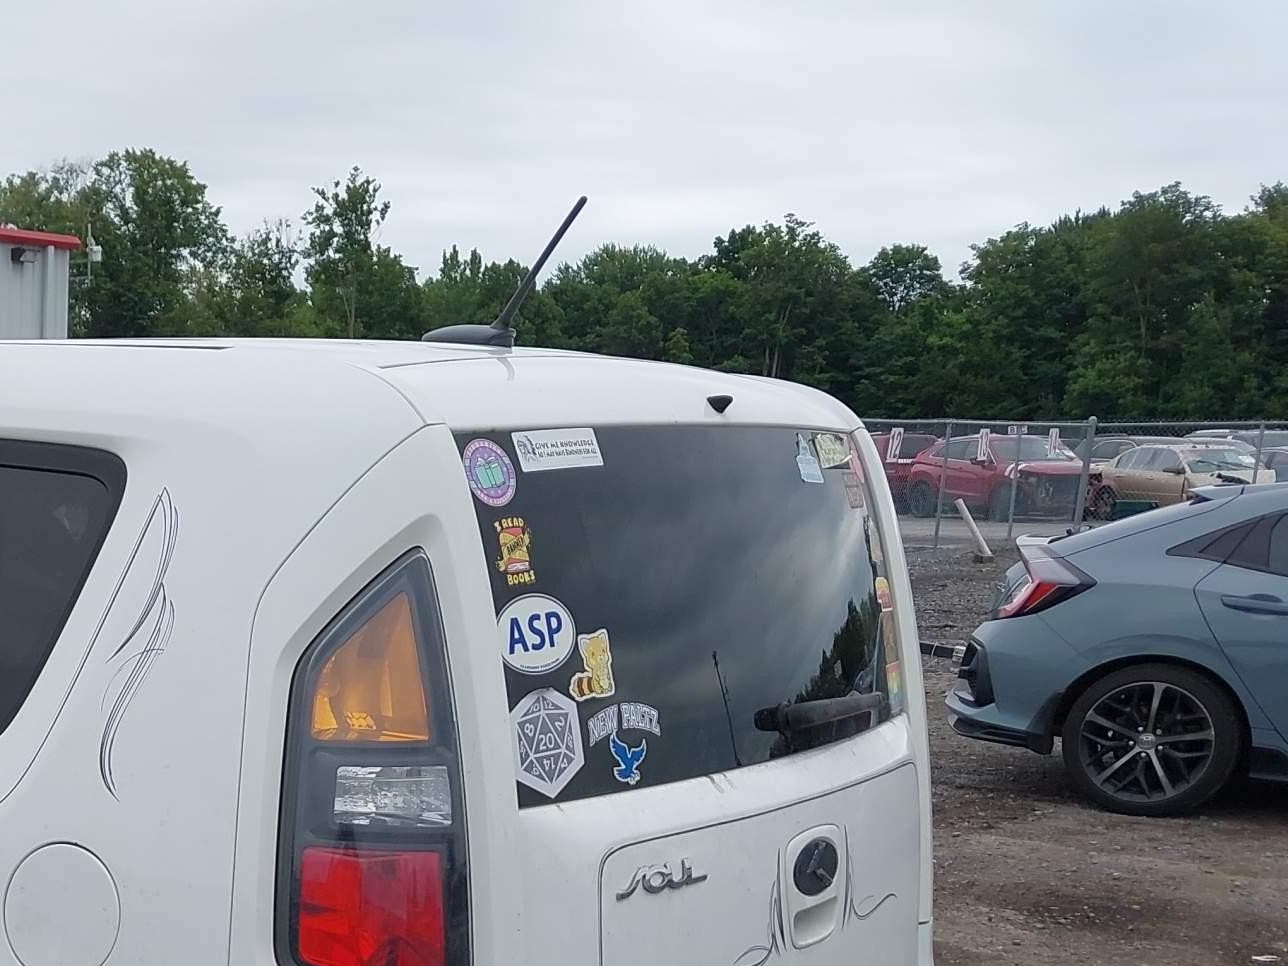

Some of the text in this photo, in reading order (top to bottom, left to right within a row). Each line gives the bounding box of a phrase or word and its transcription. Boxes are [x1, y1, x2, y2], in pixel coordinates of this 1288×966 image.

[534, 441, 550, 449] GIVE
[560, 439, 595, 447] KNOWLEDGE
[888, 430, 902, 459] 12
[501, 516, 525, 529] READ
[507, 569, 535, 585] BOOKS
[508, 611, 563, 655] ASP
[544, 700, 555, 709] 12
[524, 722, 535, 737] 8
[555, 716, 565, 731] 2
[587, 704, 619, 747] NEW
[619, 702, 661, 736] PALTZ
[538, 732, 555, 751] 20
